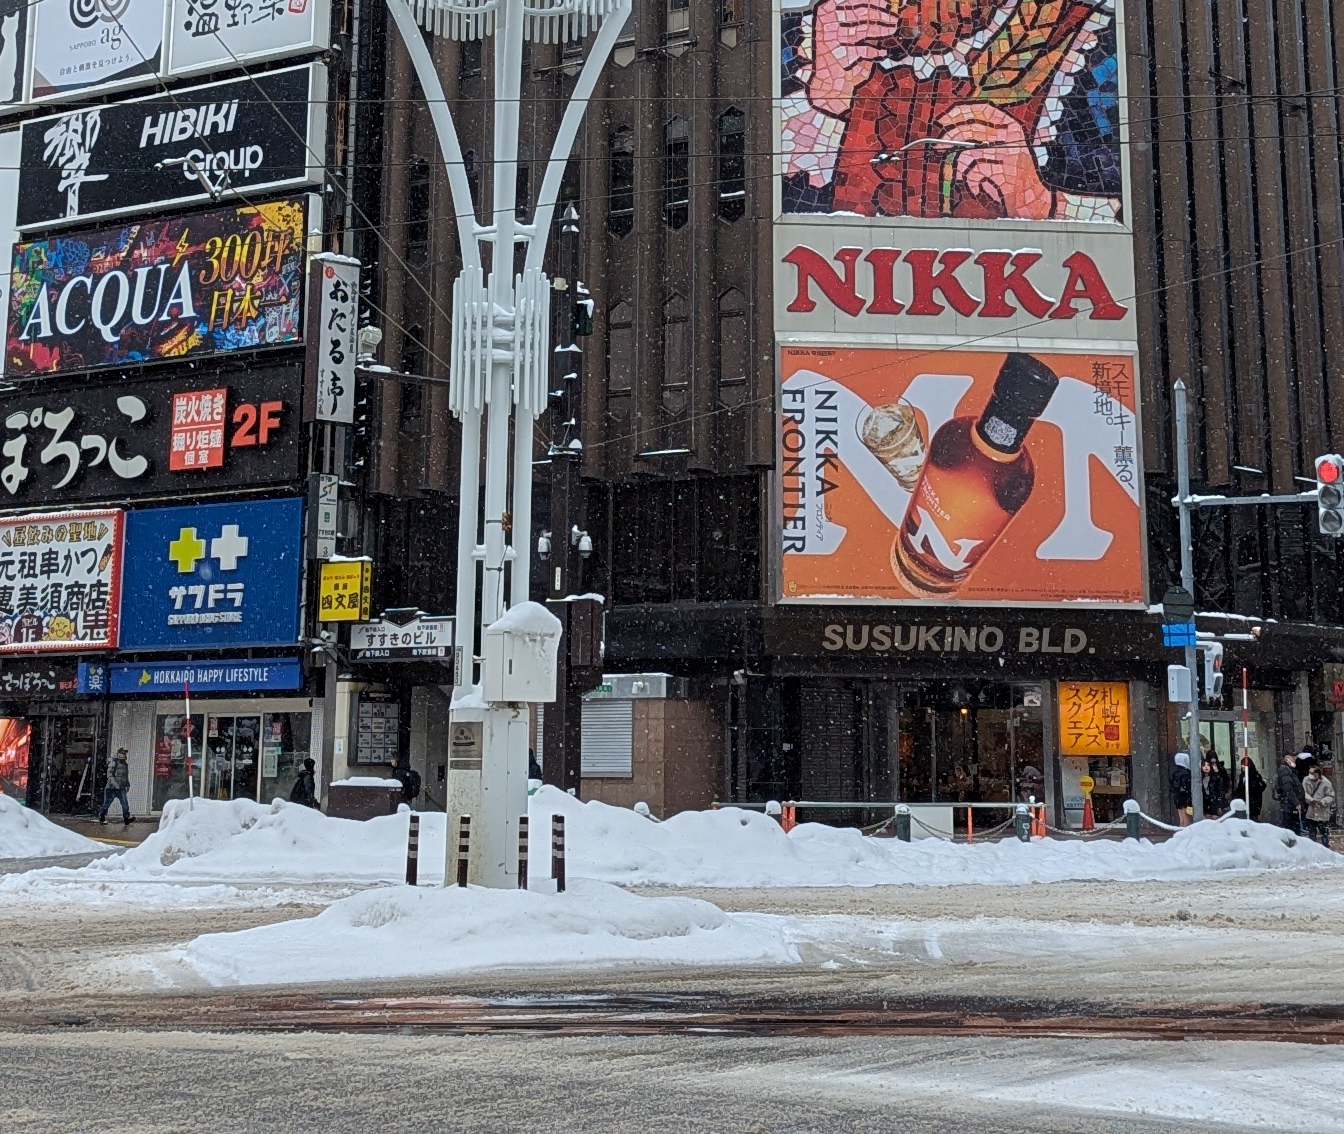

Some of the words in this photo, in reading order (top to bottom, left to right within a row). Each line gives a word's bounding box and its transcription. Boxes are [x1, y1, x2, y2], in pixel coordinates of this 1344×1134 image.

[100, 23, 124, 51] ag
[139, 99, 239, 150] HIBIKI
[182, 143, 265, 182] Group
[198, 227, 296, 286] 300坪
[19, 260, 199, 343] ACQUA
[782, 243, 1128, 321] NIKKA
[207, 284, 291, 332] 日本一
[173, 392, 225, 425] 炭火焼き
[1091, 360, 1114, 426] 新境地。
[231, 401, 284, 447] 2F
[814, 389, 839, 498] NIKKA
[1111, 361, 1135, 490] スモーキー薫る、
[184, 450, 210, 467] 個室
[781, 388, 807, 554] FRONTIER
[13, 519, 98, 547] 昼飲みの聖地
[20, 627, 37, 643] 1F
[365, 632, 437, 647] すすきのビル
[820, 622, 1006, 654] SUSUKINO
[1017, 625, 1098, 657] BLD.
[153, 668, 195, 684] HOKKAIDO
[196, 668, 224, 684] HAPPY
[225, 667, 269, 683] LIFESTYLE
[1065, 687, 1085, 749] スクエア
[1084, 686, 1105, 748] タイムズ
